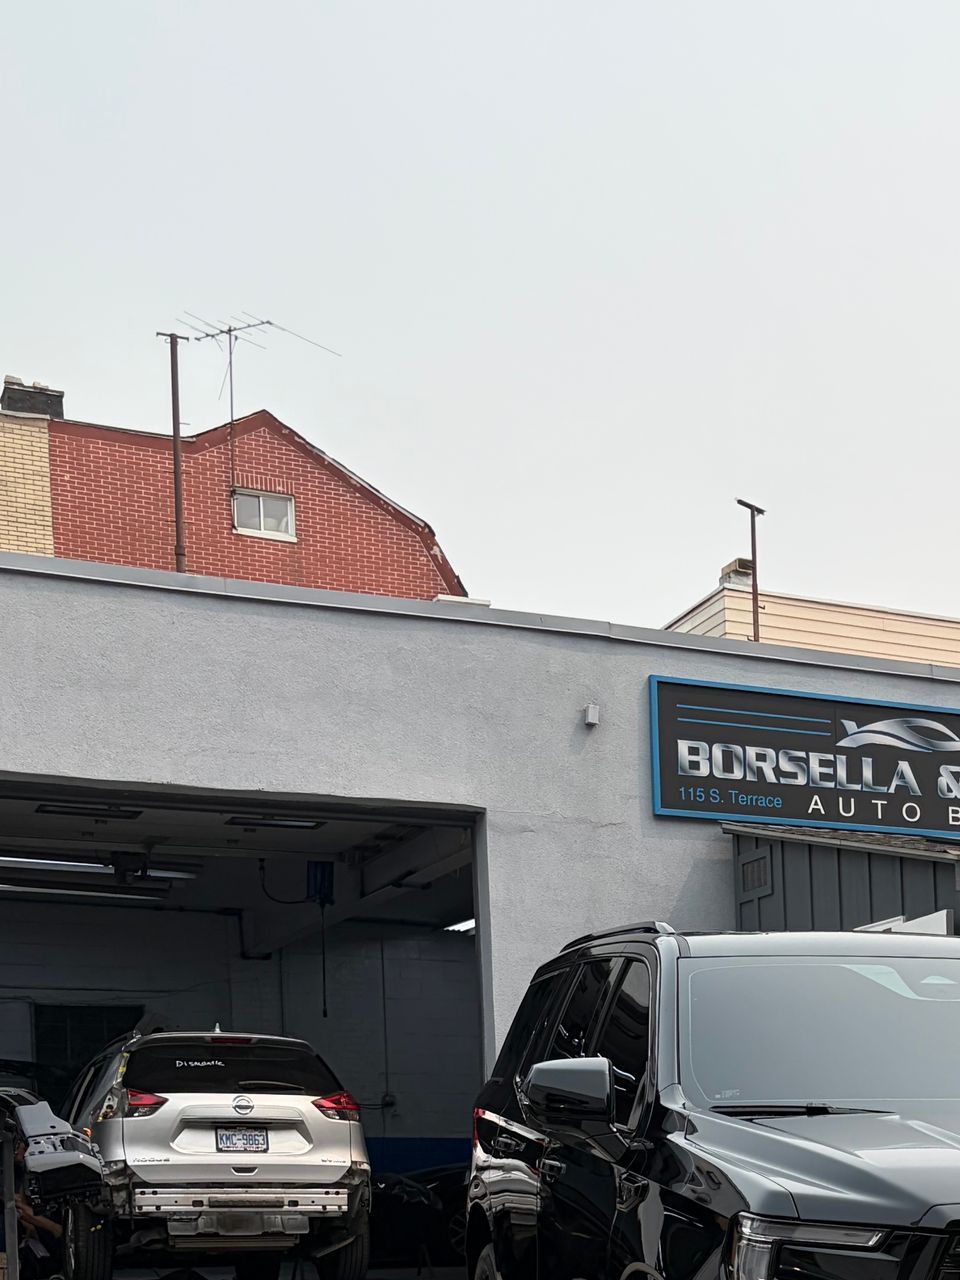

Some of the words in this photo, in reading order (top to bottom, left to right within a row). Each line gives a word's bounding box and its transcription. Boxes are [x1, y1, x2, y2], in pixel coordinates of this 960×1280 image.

[677, 739, 922, 796] BORSELLA
[679, 786, 705, 802] 115
[709, 788, 724, 804] S.
[728, 790, 783, 809] Terrace
[807, 795, 921, 822] AUTO
